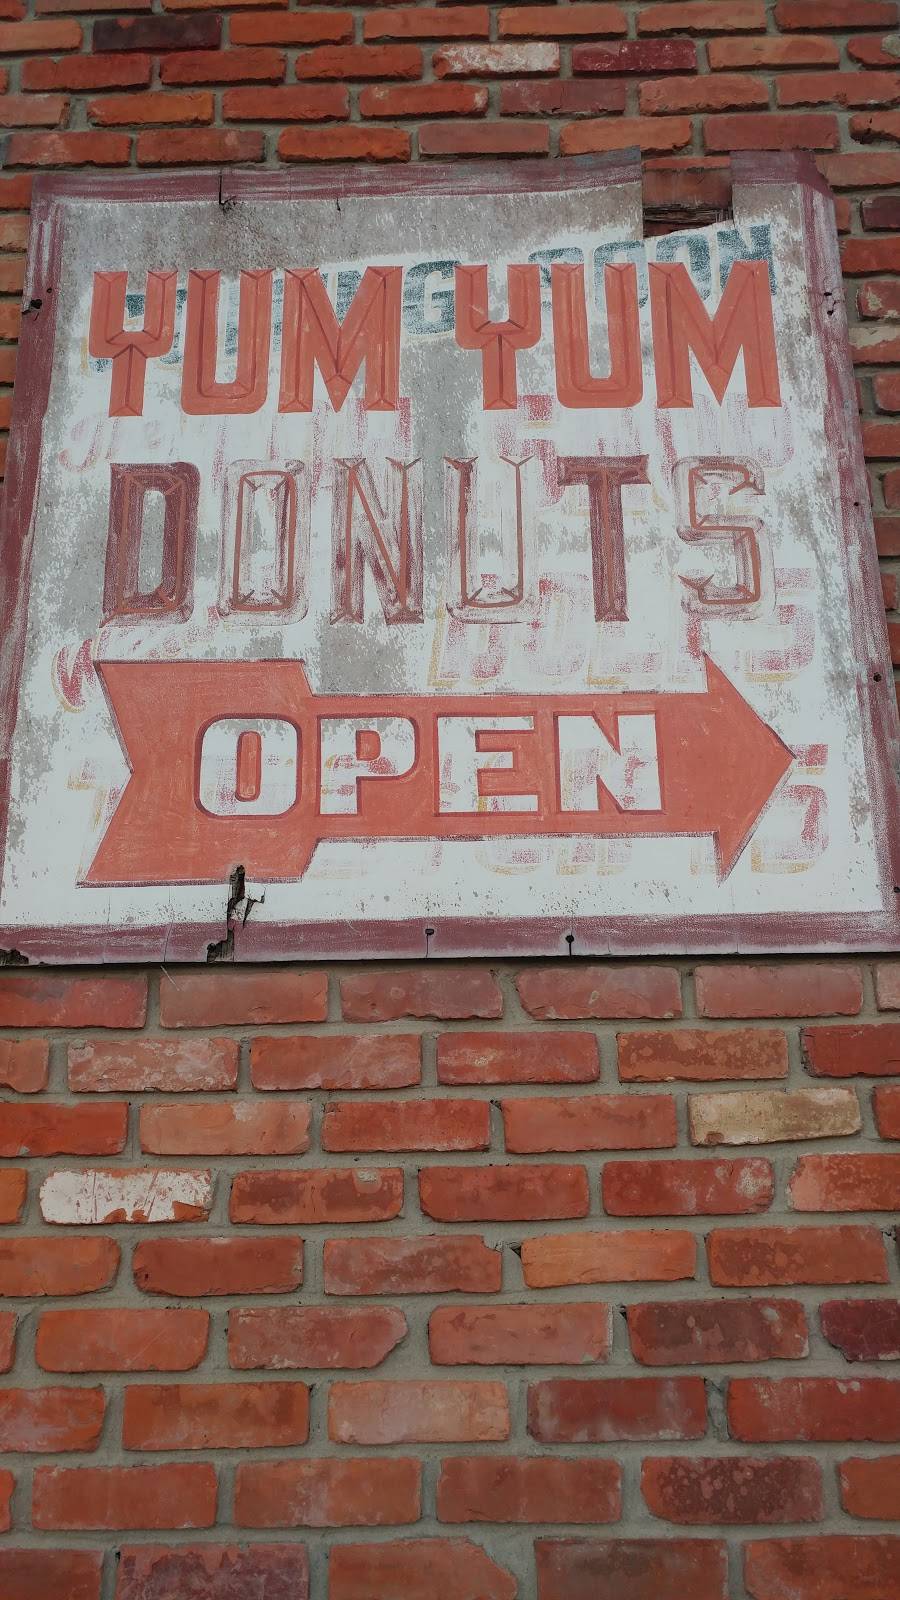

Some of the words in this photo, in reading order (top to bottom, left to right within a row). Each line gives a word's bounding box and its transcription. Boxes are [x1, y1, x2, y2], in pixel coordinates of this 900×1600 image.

[88, 265, 403, 417] YUM
[454, 261, 782, 411] YUM
[100, 455, 776, 628] DONUTS
[194, 711, 665, 820] OPEN
